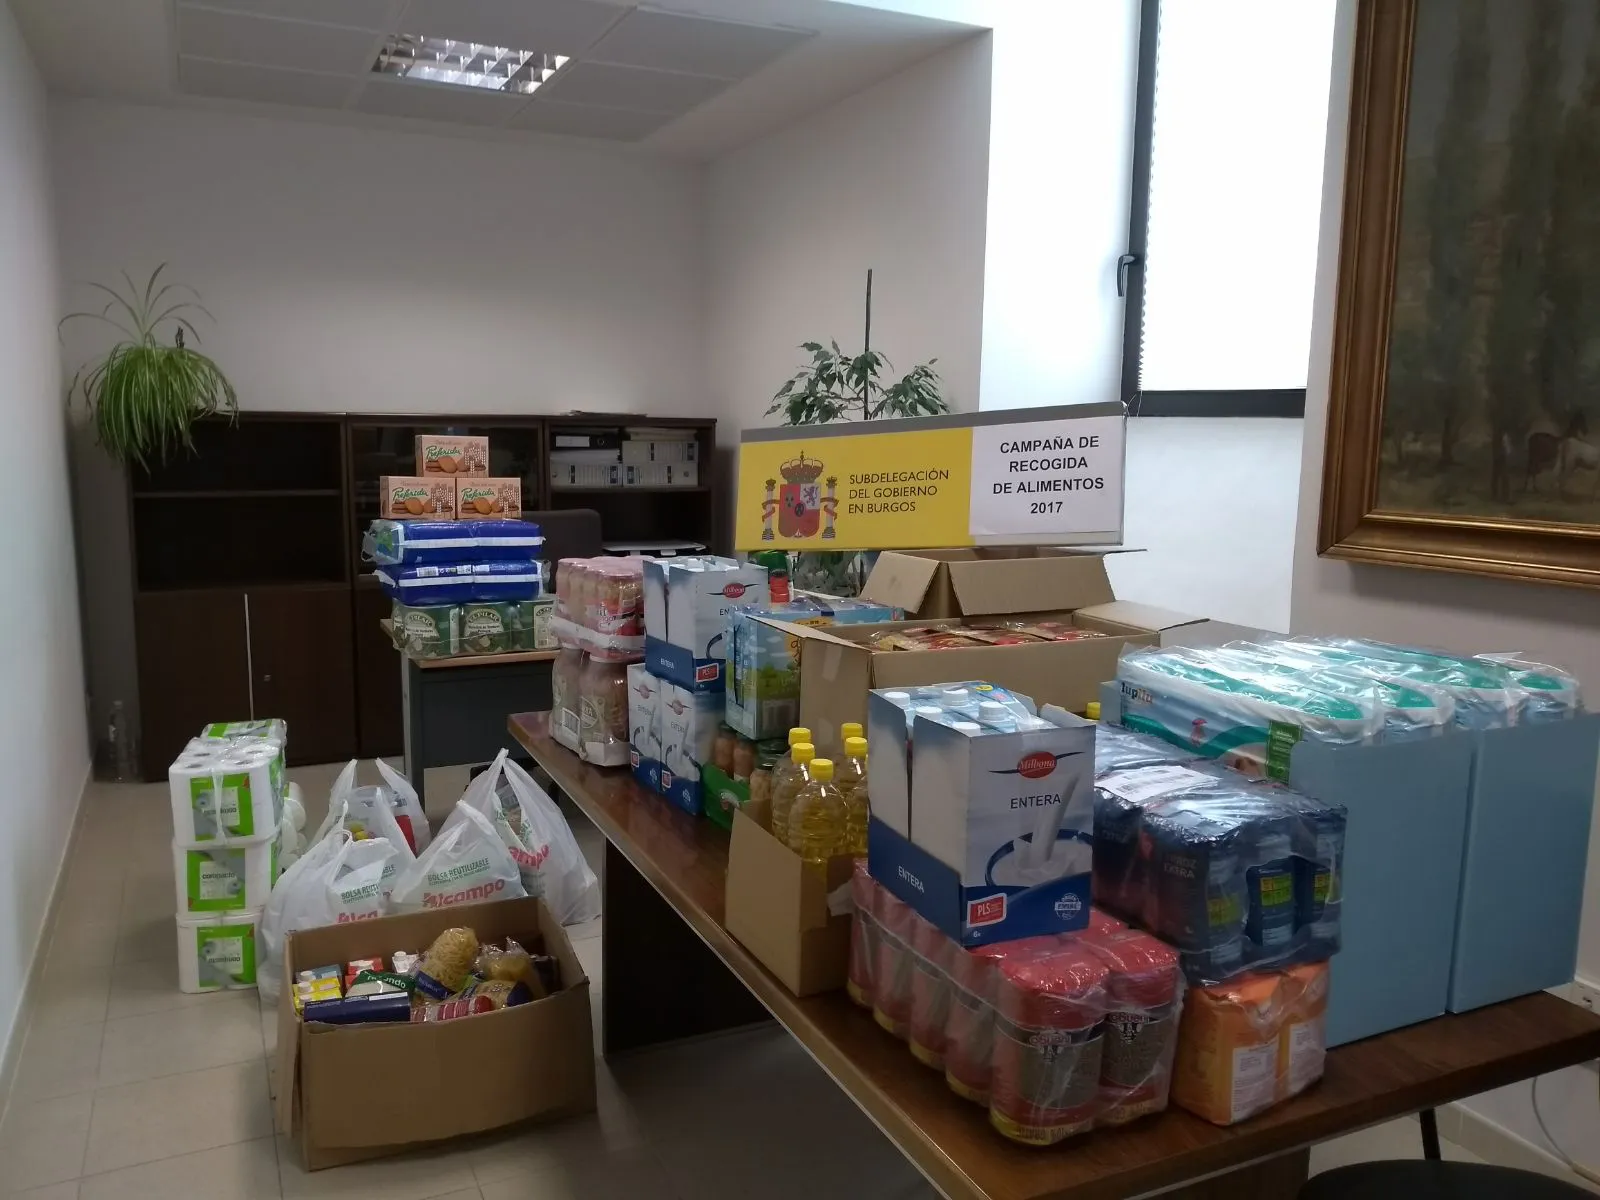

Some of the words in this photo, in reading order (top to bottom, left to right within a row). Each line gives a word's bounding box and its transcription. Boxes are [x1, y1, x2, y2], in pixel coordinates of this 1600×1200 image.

[1000, 436, 1074, 453] CAMPAÑA
[1078, 435, 1100, 448] DE
[1009, 457, 1088, 472] RECOGIDA
[849, 468, 949, 484] SUBDELEGACIÓN
[849, 489, 870, 499] DEL
[874, 485, 937, 498] GOBIERNO
[993, 483, 1012, 494] DE
[1016, 478, 1104, 493] ALIMENTOS
[848, 503, 864, 514] EN
[867, 501, 916, 513] BURGOS
[1030, 501, 1063, 514] 2017
[1010, 794, 1061, 809] ENTERA
[898, 865, 925, 893] ENTERA
[341, 888, 361, 899] BOLSA
[422, 879, 505, 908] Alcampo
[977, 902, 991, 916] PLS
